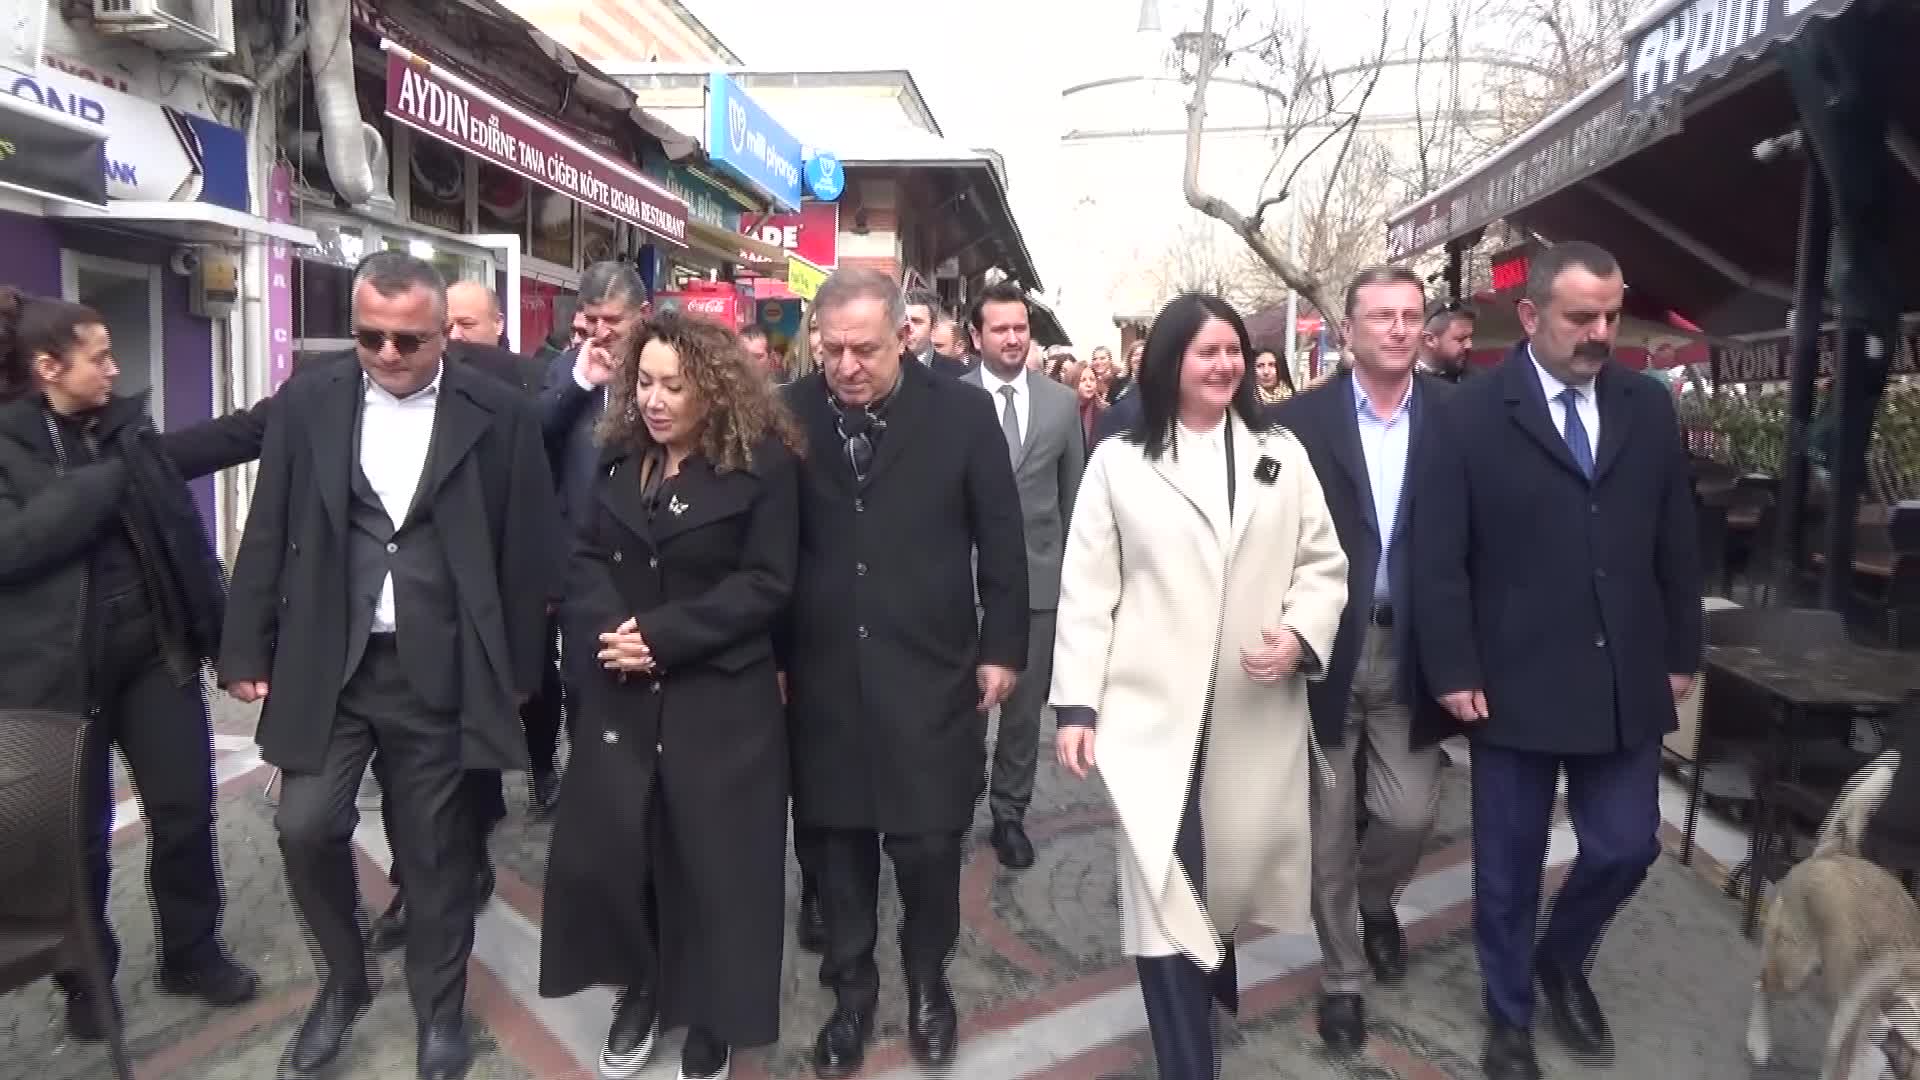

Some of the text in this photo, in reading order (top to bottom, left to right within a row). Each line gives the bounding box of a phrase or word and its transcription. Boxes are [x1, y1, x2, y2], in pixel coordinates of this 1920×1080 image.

[398, 67, 470, 140] AYDIN
[470, 116, 517, 162] EDİRNE
[518, 140, 546, 177] TAVA
[547, 152, 579, 191] CİĞER
[579, 170, 609, 207] KÖFTE
[641, 201, 686, 239] RESTAURANT
[1719, 343, 1780, 382] AYDIN
